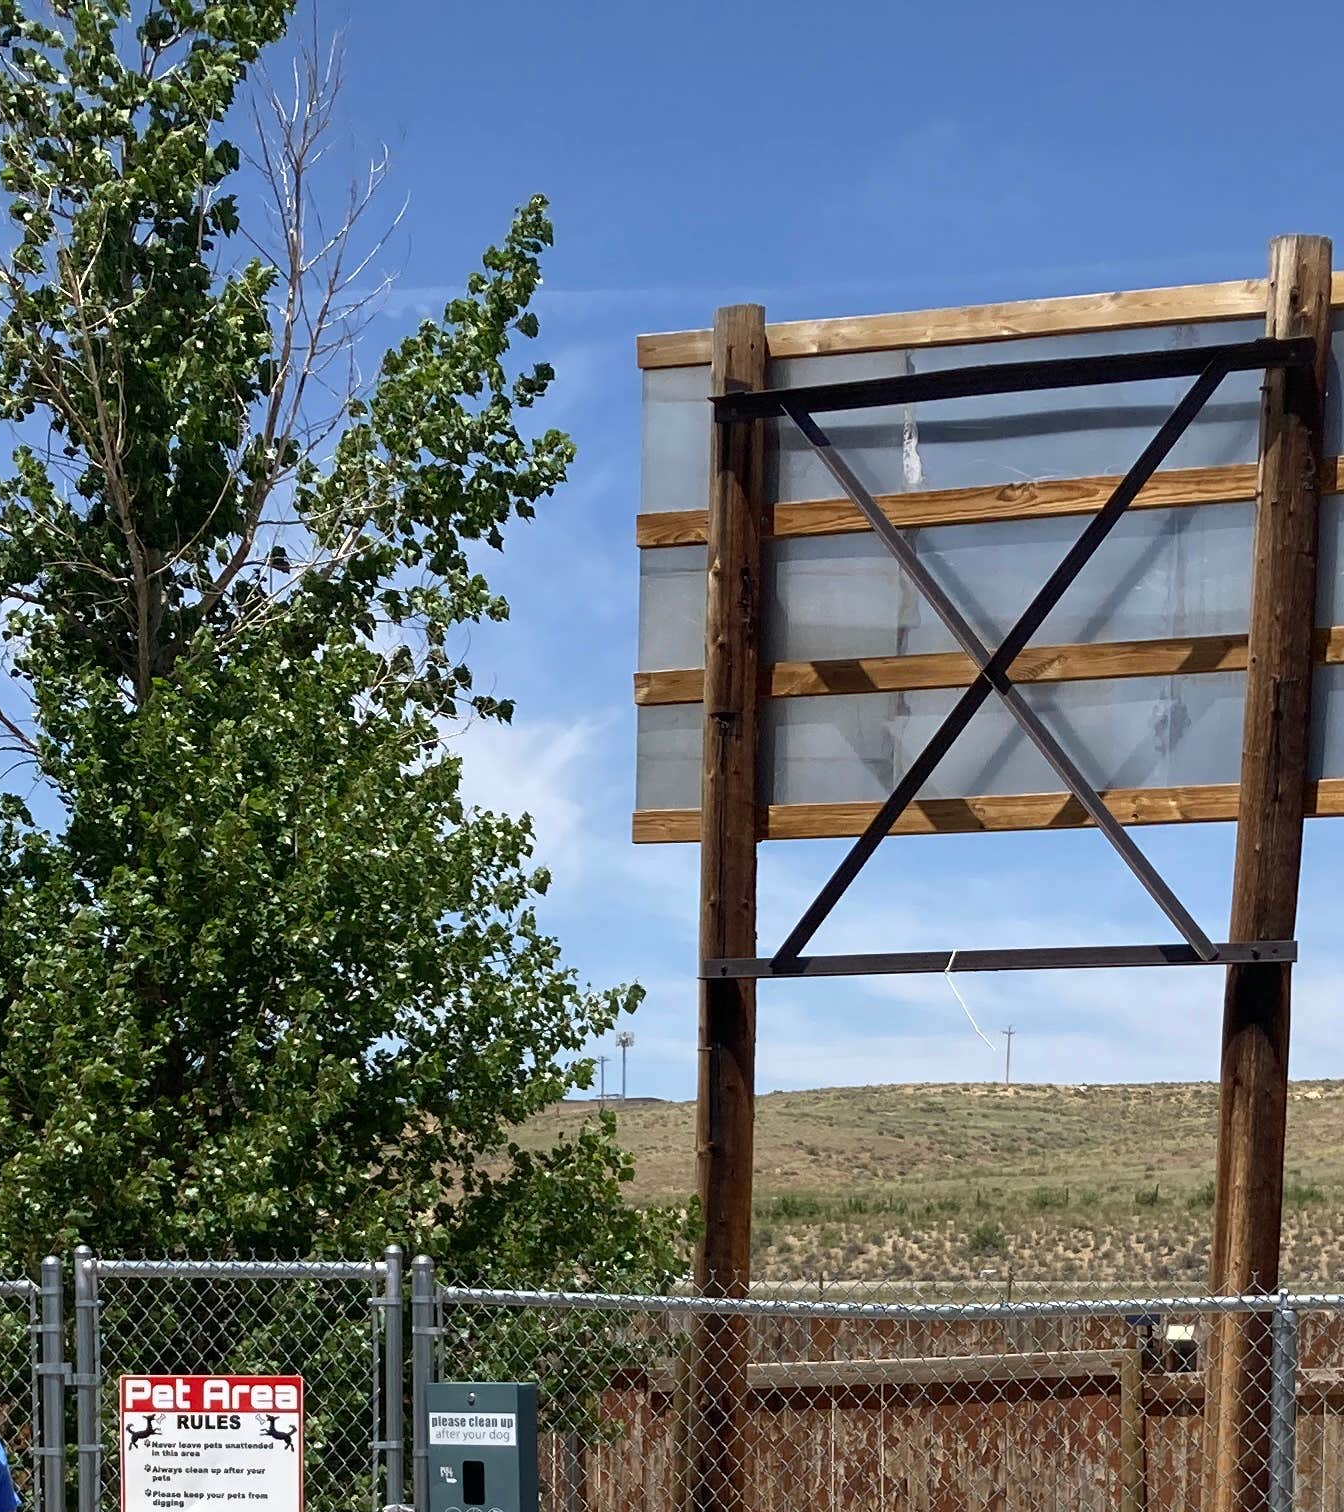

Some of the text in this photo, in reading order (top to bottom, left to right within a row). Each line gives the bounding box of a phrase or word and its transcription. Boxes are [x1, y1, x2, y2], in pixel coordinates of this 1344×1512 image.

[126, 1378, 298, 1410] Pet Area
[177, 1415, 241, 1430] RULES
[432, 1416, 513, 1428] please clean up
[436, 1428, 510, 1442] after your dog
[204, 1442, 222, 1450] pets
[152, 1466, 182, 1474] Always
[185, 1466, 208, 1474] clean
[184, 1491, 204, 1499] keep
[227, 1492, 245, 1500] pets
[153, 1499, 184, 1507] digging
